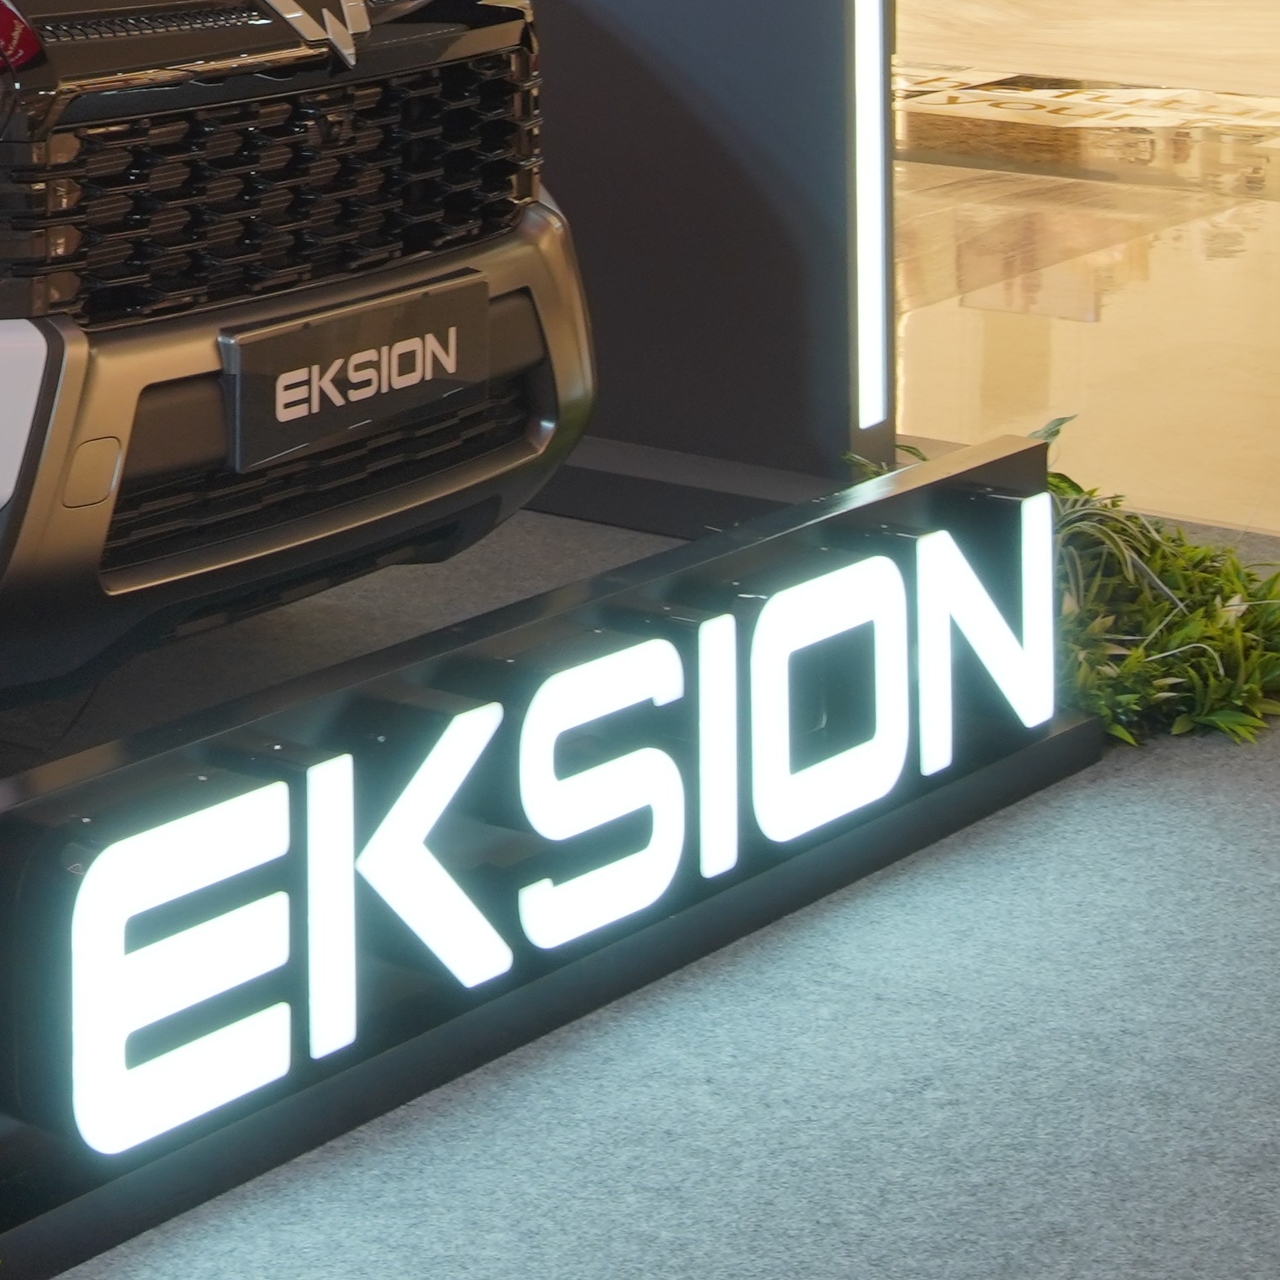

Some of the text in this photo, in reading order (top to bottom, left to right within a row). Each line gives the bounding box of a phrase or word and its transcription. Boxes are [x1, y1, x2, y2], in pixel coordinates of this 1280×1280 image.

[894, 74, 1034, 94] he
[916, 95, 1158, 121] your
[275, 326, 457, 423] EKSION
[71, 491, 1055, 1156] EKSION
